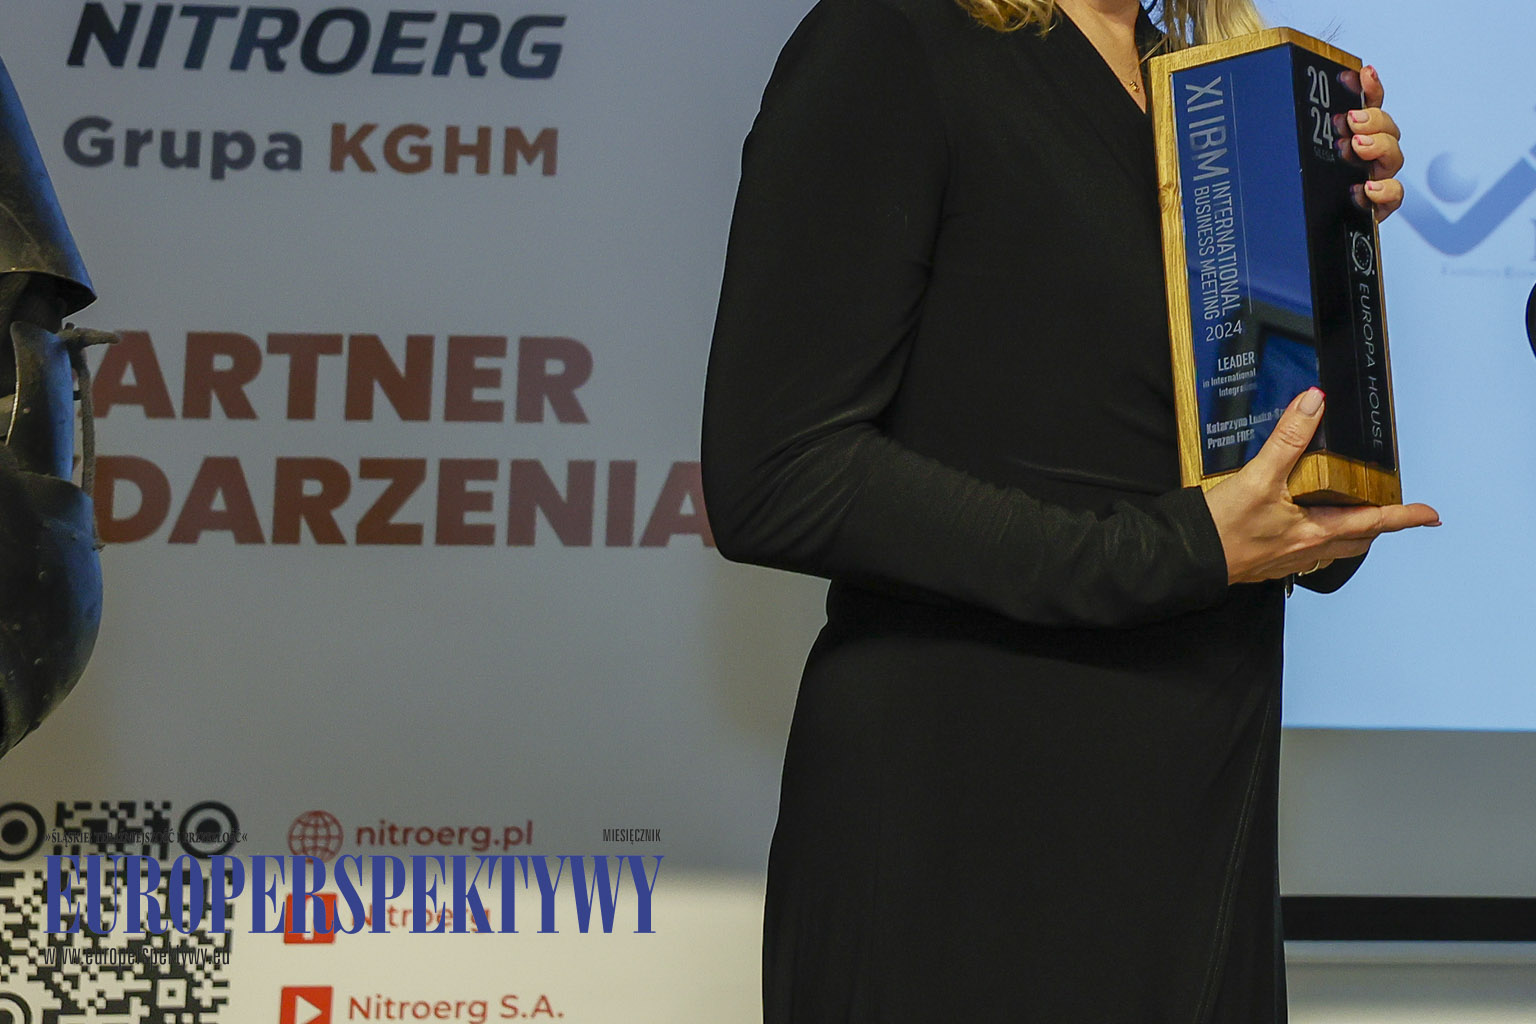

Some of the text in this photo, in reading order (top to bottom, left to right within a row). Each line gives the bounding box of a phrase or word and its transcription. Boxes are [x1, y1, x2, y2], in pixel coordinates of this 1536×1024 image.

[66, 0, 568, 80] NITROERG
[1307, 65, 1330, 108] 20
[62, 115, 559, 180] Grupa KGHM
[1185, 76, 1230, 181] XI IBM
[1311, 106, 1333, 150] 24
[1194, 184, 1221, 321] BUSINESS MEETING
[1212, 180, 1241, 317] INTERNATIONAL
[1205, 319, 1243, 343] 2024
[1217, 351, 1256, 372] LEADER
[90, 330, 595, 425] ARTNER
[1211, 367, 1257, 387] International
[1358, 282, 1383, 450] EUROPA HOUSE
[94, 453, 718, 550] DARZENIA
[356, 819, 534, 852] nitroerg.pl
[348, 994, 566, 1024] Nitroerg S.A.
